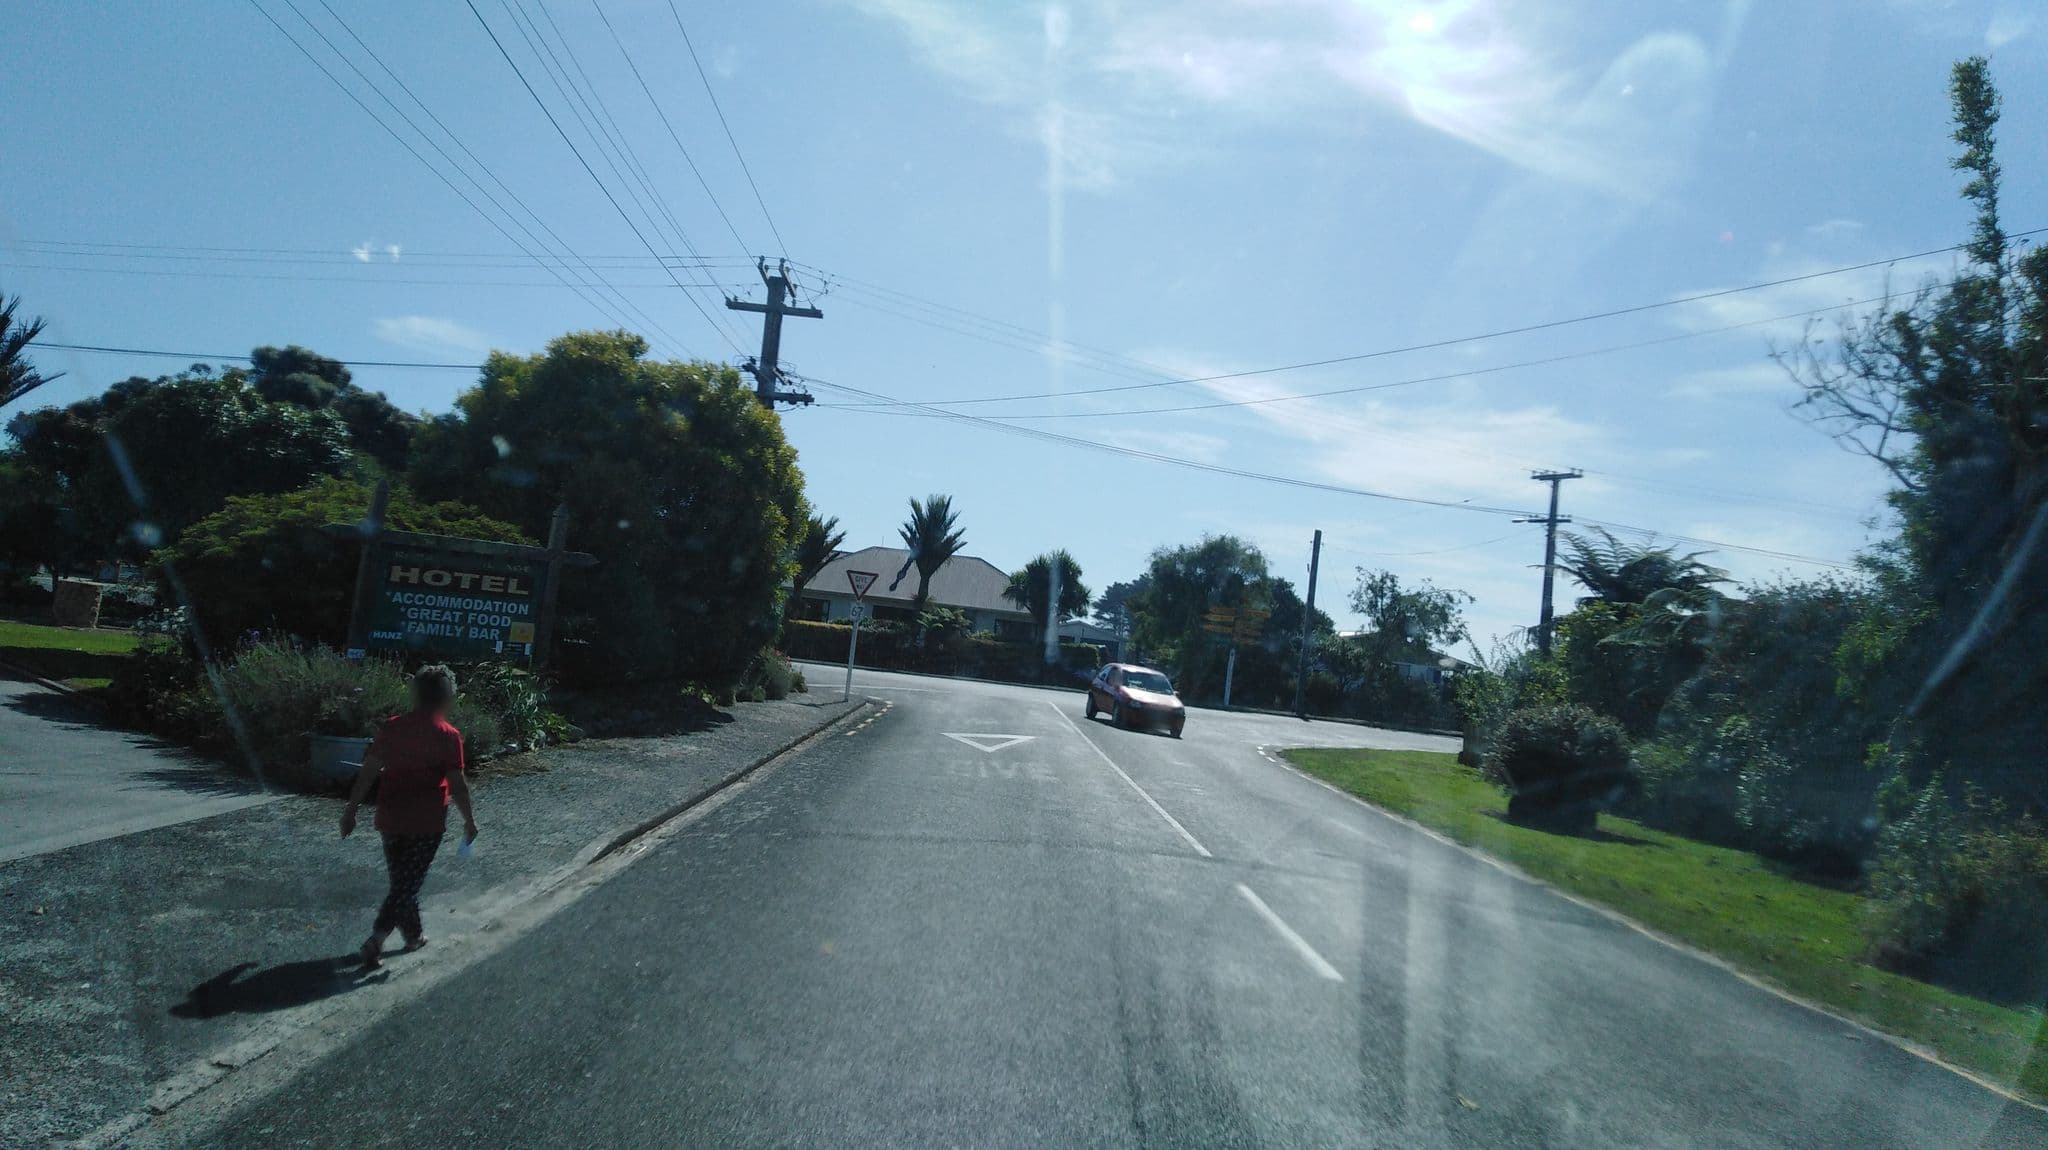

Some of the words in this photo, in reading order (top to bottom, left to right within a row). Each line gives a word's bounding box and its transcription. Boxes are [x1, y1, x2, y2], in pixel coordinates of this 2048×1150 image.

[389, 565, 528, 594] HOTEL
[391, 590, 528, 614] ACCOMMODATION
[407, 605, 462, 622] GREAT
[467, 613, 512, 628] FOOD
[407, 621, 464, 637] FAMILY
[468, 627, 500, 640] BAR
